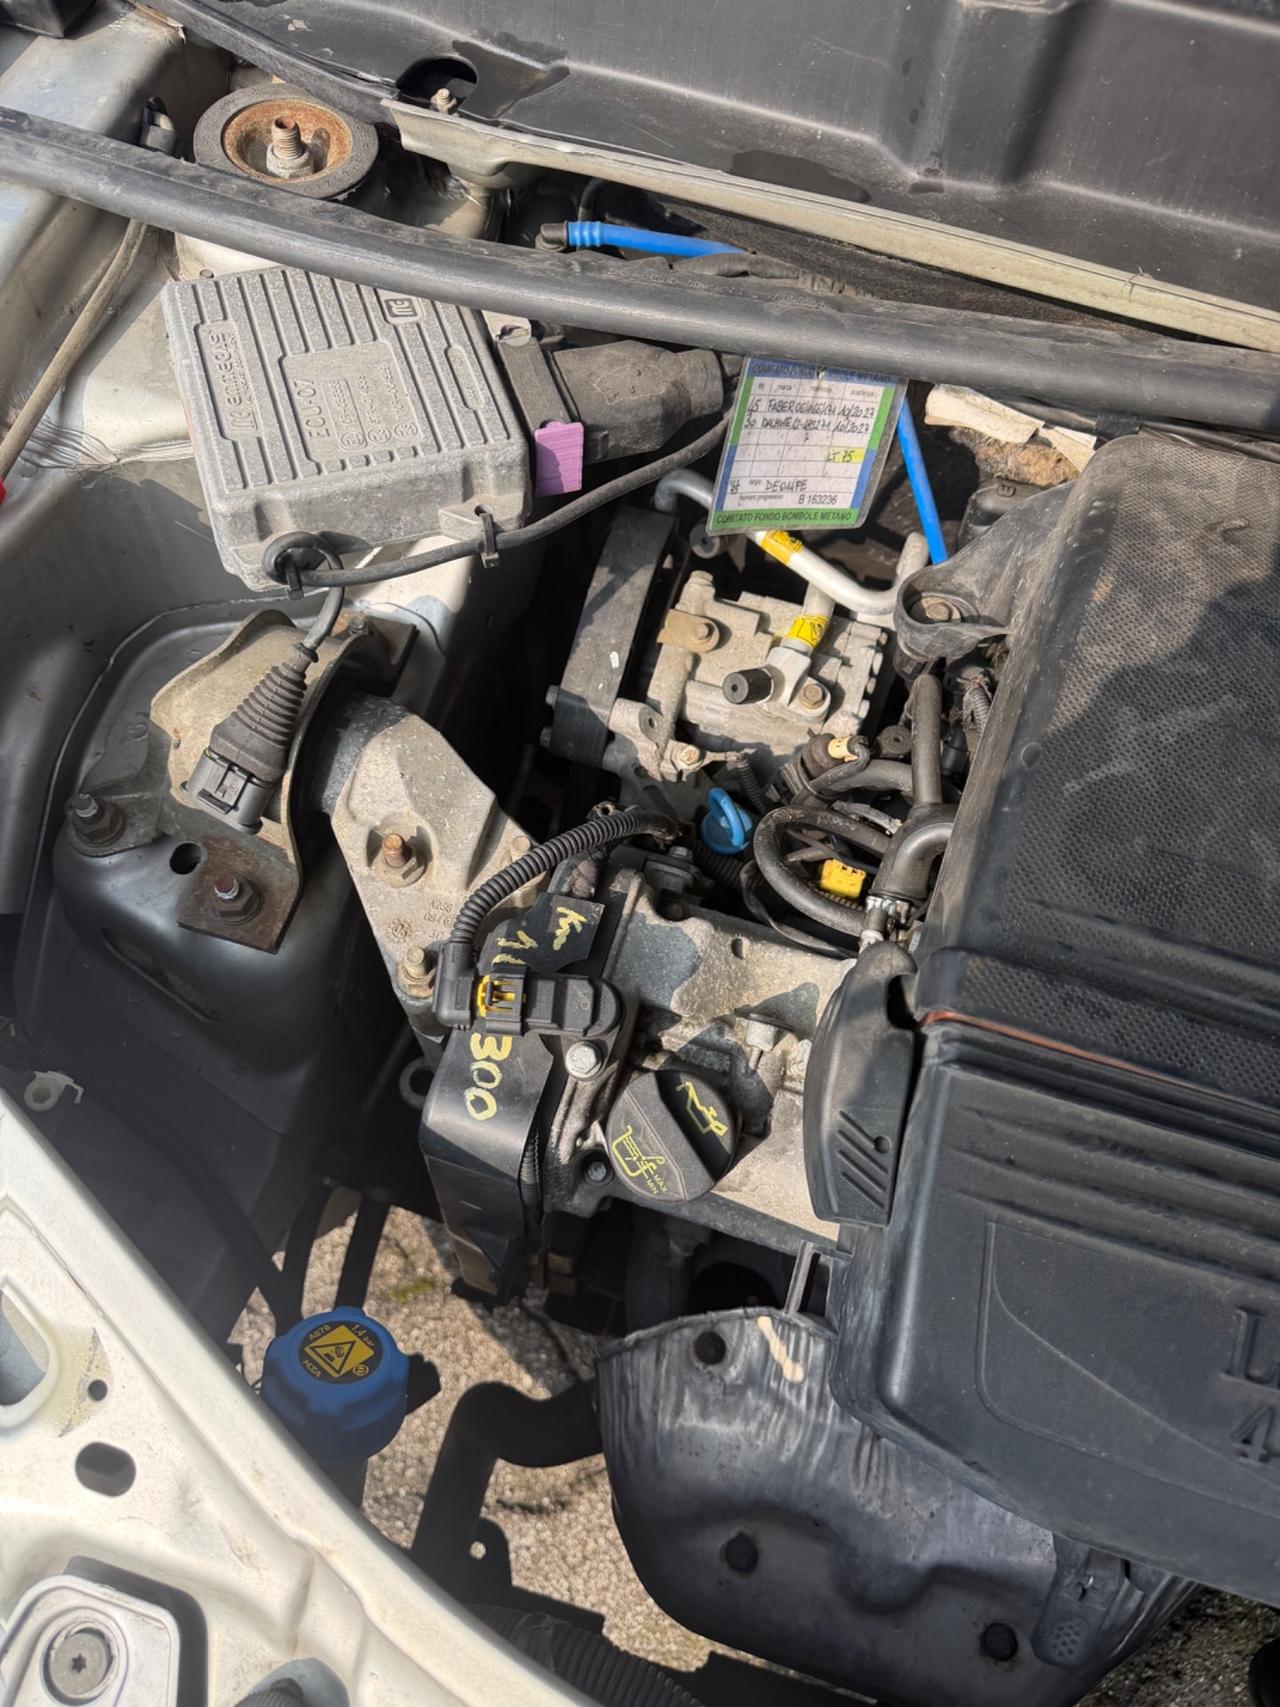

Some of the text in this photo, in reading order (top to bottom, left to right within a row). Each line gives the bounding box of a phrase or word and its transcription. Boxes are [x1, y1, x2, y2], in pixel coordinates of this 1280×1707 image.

[292, 379, 331, 440] ECU-07
[768, 398, 795, 413] FABER
[842, 449, 856, 463] 75
[798, 494, 838, 505] B 163236
[716, 508, 851, 524] COMITATO FONDO BOMBOLE METANO
[463, 1031, 513, 1121] 300
[647, 1179, 660, 1195] MIN
[654, 1174, 668, 1193] MAX
